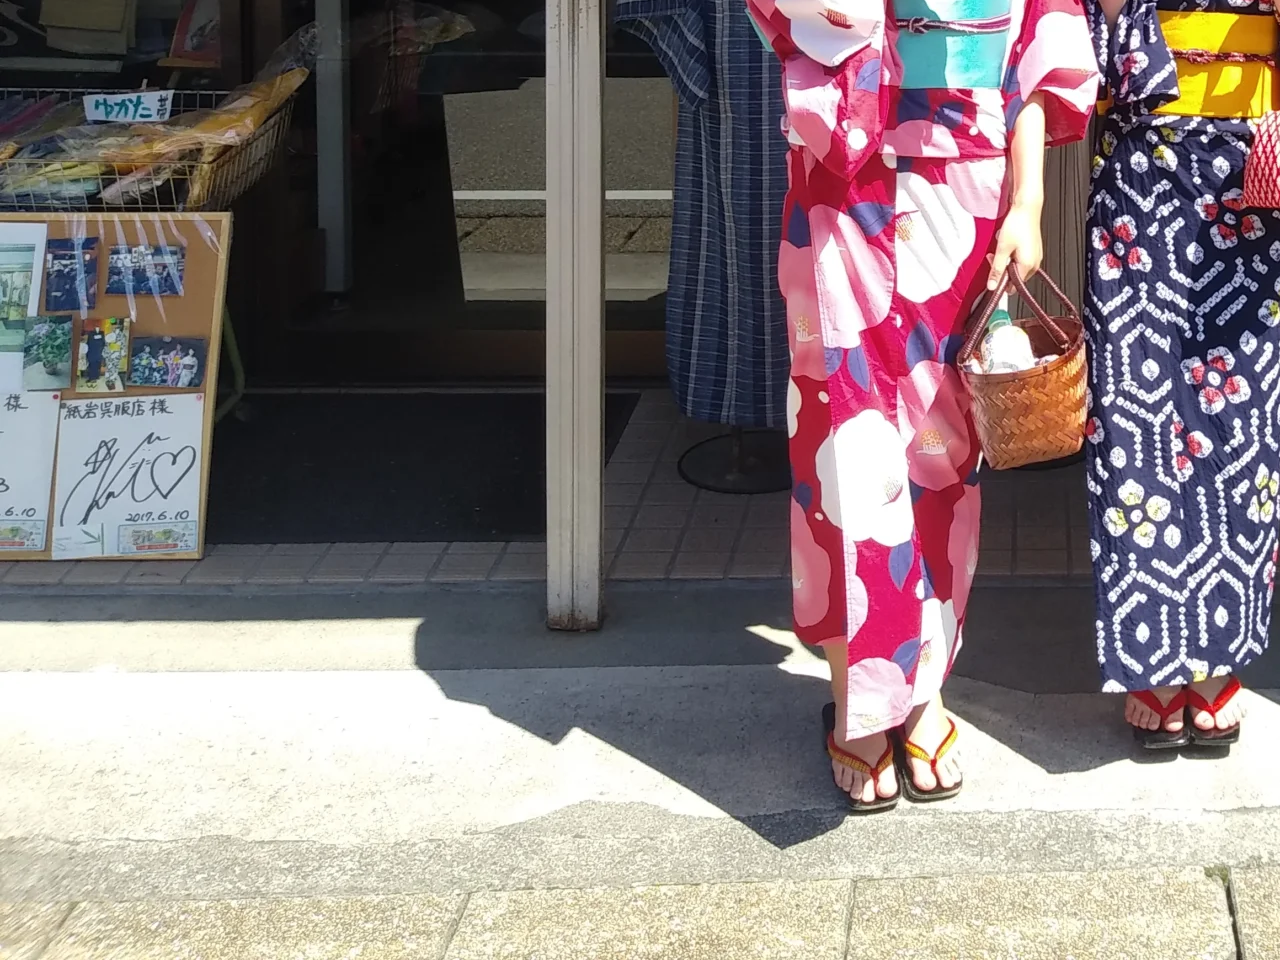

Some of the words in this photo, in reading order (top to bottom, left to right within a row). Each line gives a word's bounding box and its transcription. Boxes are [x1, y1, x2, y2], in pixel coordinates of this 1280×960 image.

[95, 95, 152, 120] ゆかた
[125, 510, 189, 522] 2017.6.10
